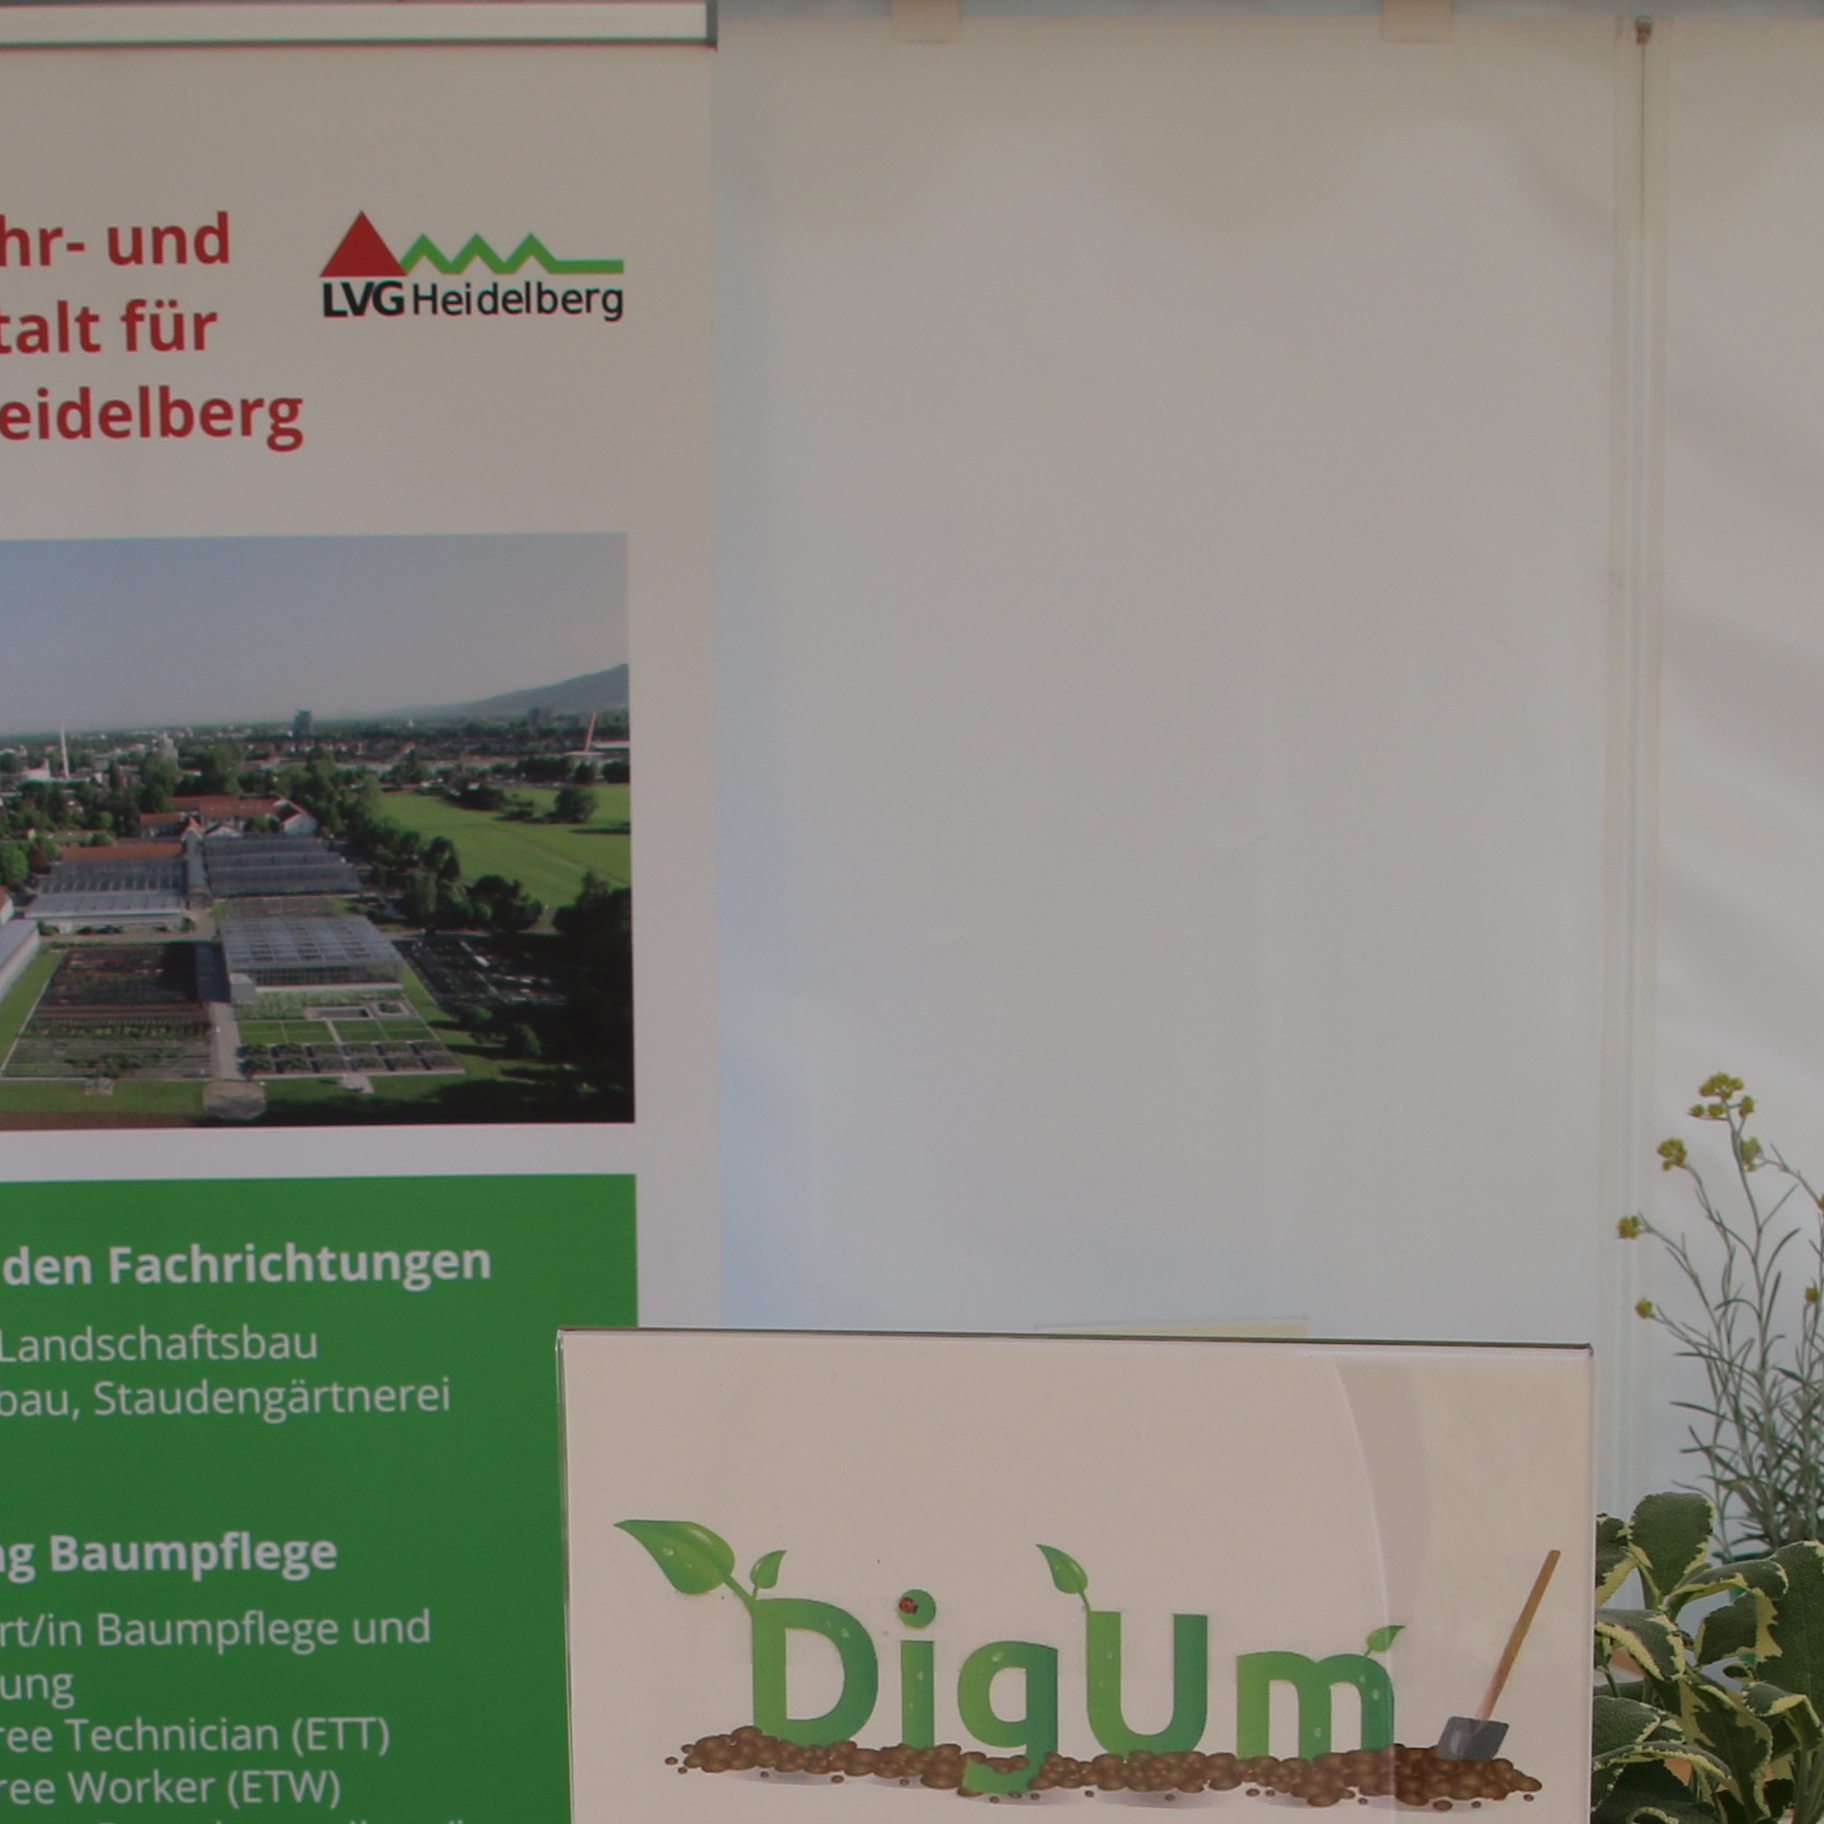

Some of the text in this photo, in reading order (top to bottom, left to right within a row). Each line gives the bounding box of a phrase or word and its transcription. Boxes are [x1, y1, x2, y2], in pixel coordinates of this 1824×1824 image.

[108, 211, 229, 266] und
[120, 299, 217, 352] für
[324, 281, 623, 322] LVG Heidelberg
[3, 1246, 92, 1286] den
[110, 1242, 490, 1292] Fachrichtungen
[94, 1376, 449, 1424] Staudengärtnerei
[50, 1531, 337, 1581] Baumpflege
[98, 1610, 339, 1655] Baumpflege
[353, 1608, 430, 1644] und
[750, 1589, 1396, 1795] DigUm
[64, 1717, 279, 1752] Technician
[292, 1717, 390, 1757] (ETT)
[67, 1769, 216, 1804] Worker
[228, 1770, 340, 1809] (ETW)
